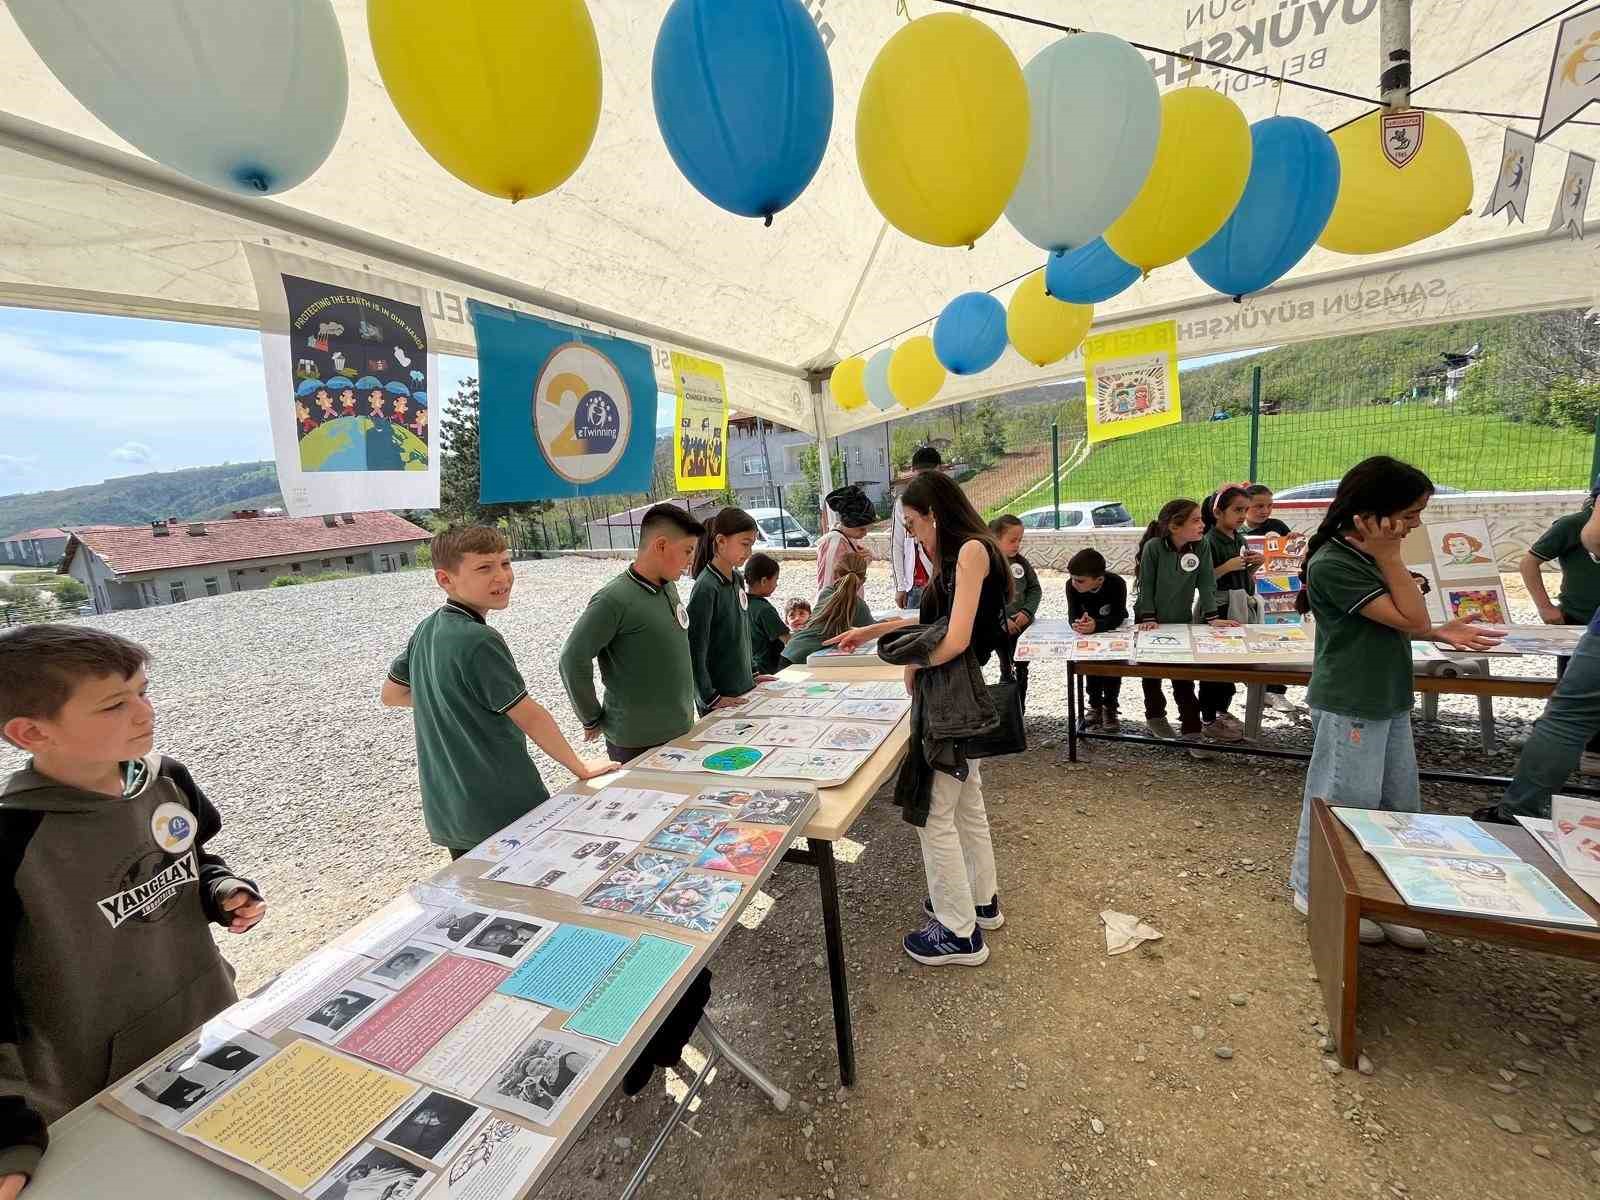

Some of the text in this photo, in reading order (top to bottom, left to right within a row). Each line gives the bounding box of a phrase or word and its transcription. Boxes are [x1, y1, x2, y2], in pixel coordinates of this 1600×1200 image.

[294, 296, 331, 329] PROTECTING
[331, 295, 345, 304] THE
[346, 295, 371, 308] EARTH
[577, 425, 617, 440] eTwinning
